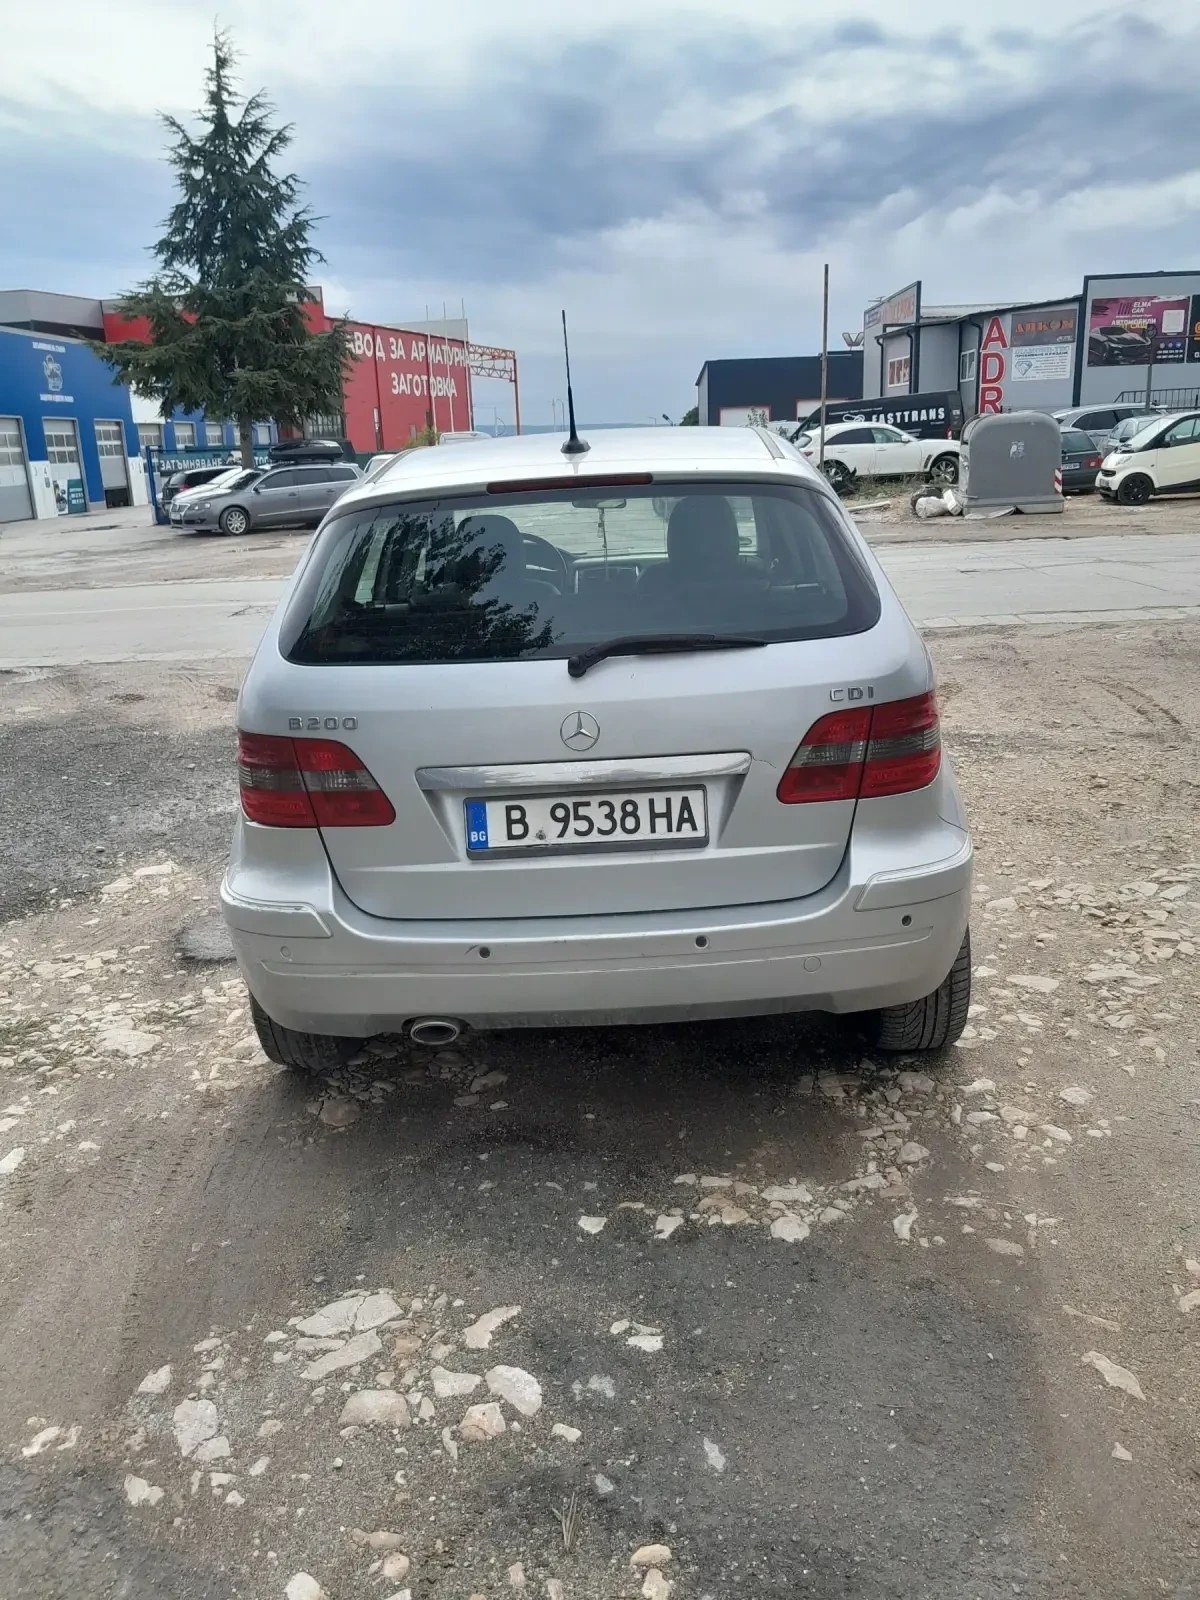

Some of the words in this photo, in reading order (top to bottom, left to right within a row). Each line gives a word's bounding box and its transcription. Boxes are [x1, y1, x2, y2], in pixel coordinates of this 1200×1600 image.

[389, 337, 406, 359] ЗА
[979, 316, 1008, 414] ADR
[391, 372, 458, 397] ЗАГОТОВКА
[871, 407, 945, 424] FASTTRANS
[830, 685, 874, 701] CDI
[288, 716, 358, 730] B200
[505, 804, 529, 840] B
[470, 831, 486, 842] BG
